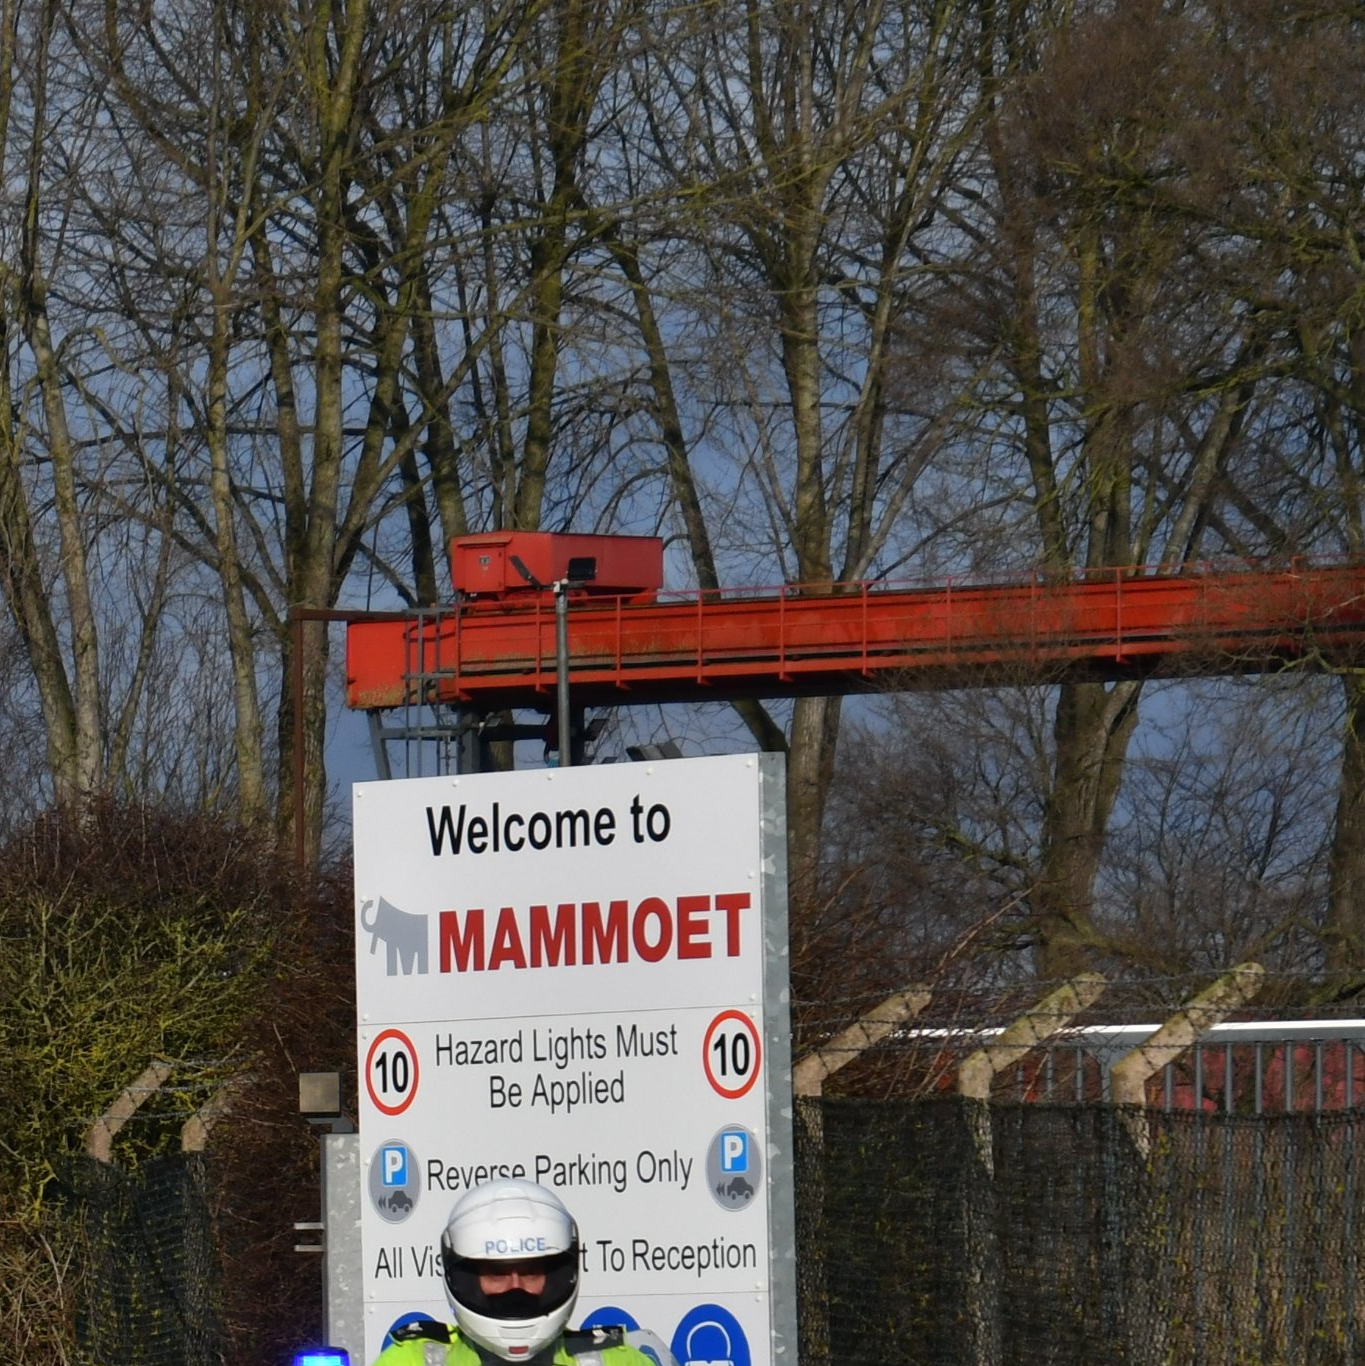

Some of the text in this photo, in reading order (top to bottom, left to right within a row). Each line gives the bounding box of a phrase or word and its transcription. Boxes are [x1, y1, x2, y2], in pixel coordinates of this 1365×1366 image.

[425, 793, 672, 856] Welcome to
[439, 892, 751, 974] MAMMOET
[434, 1023, 679, 1070] Hazard Lights Must
[713, 1032, 751, 1077] 10
[375, 1050, 409, 1093] 10
[489, 1070, 625, 1114] Be Applied
[384, 1150, 403, 1183] P
[427, 1149, 693, 1193] Reverse Parking Only
[723, 1134, 744, 1169] P
[375, 1246, 403, 1280] All
[596, 1239, 625, 1273] To
[632, 1238, 757, 1277] Reception
